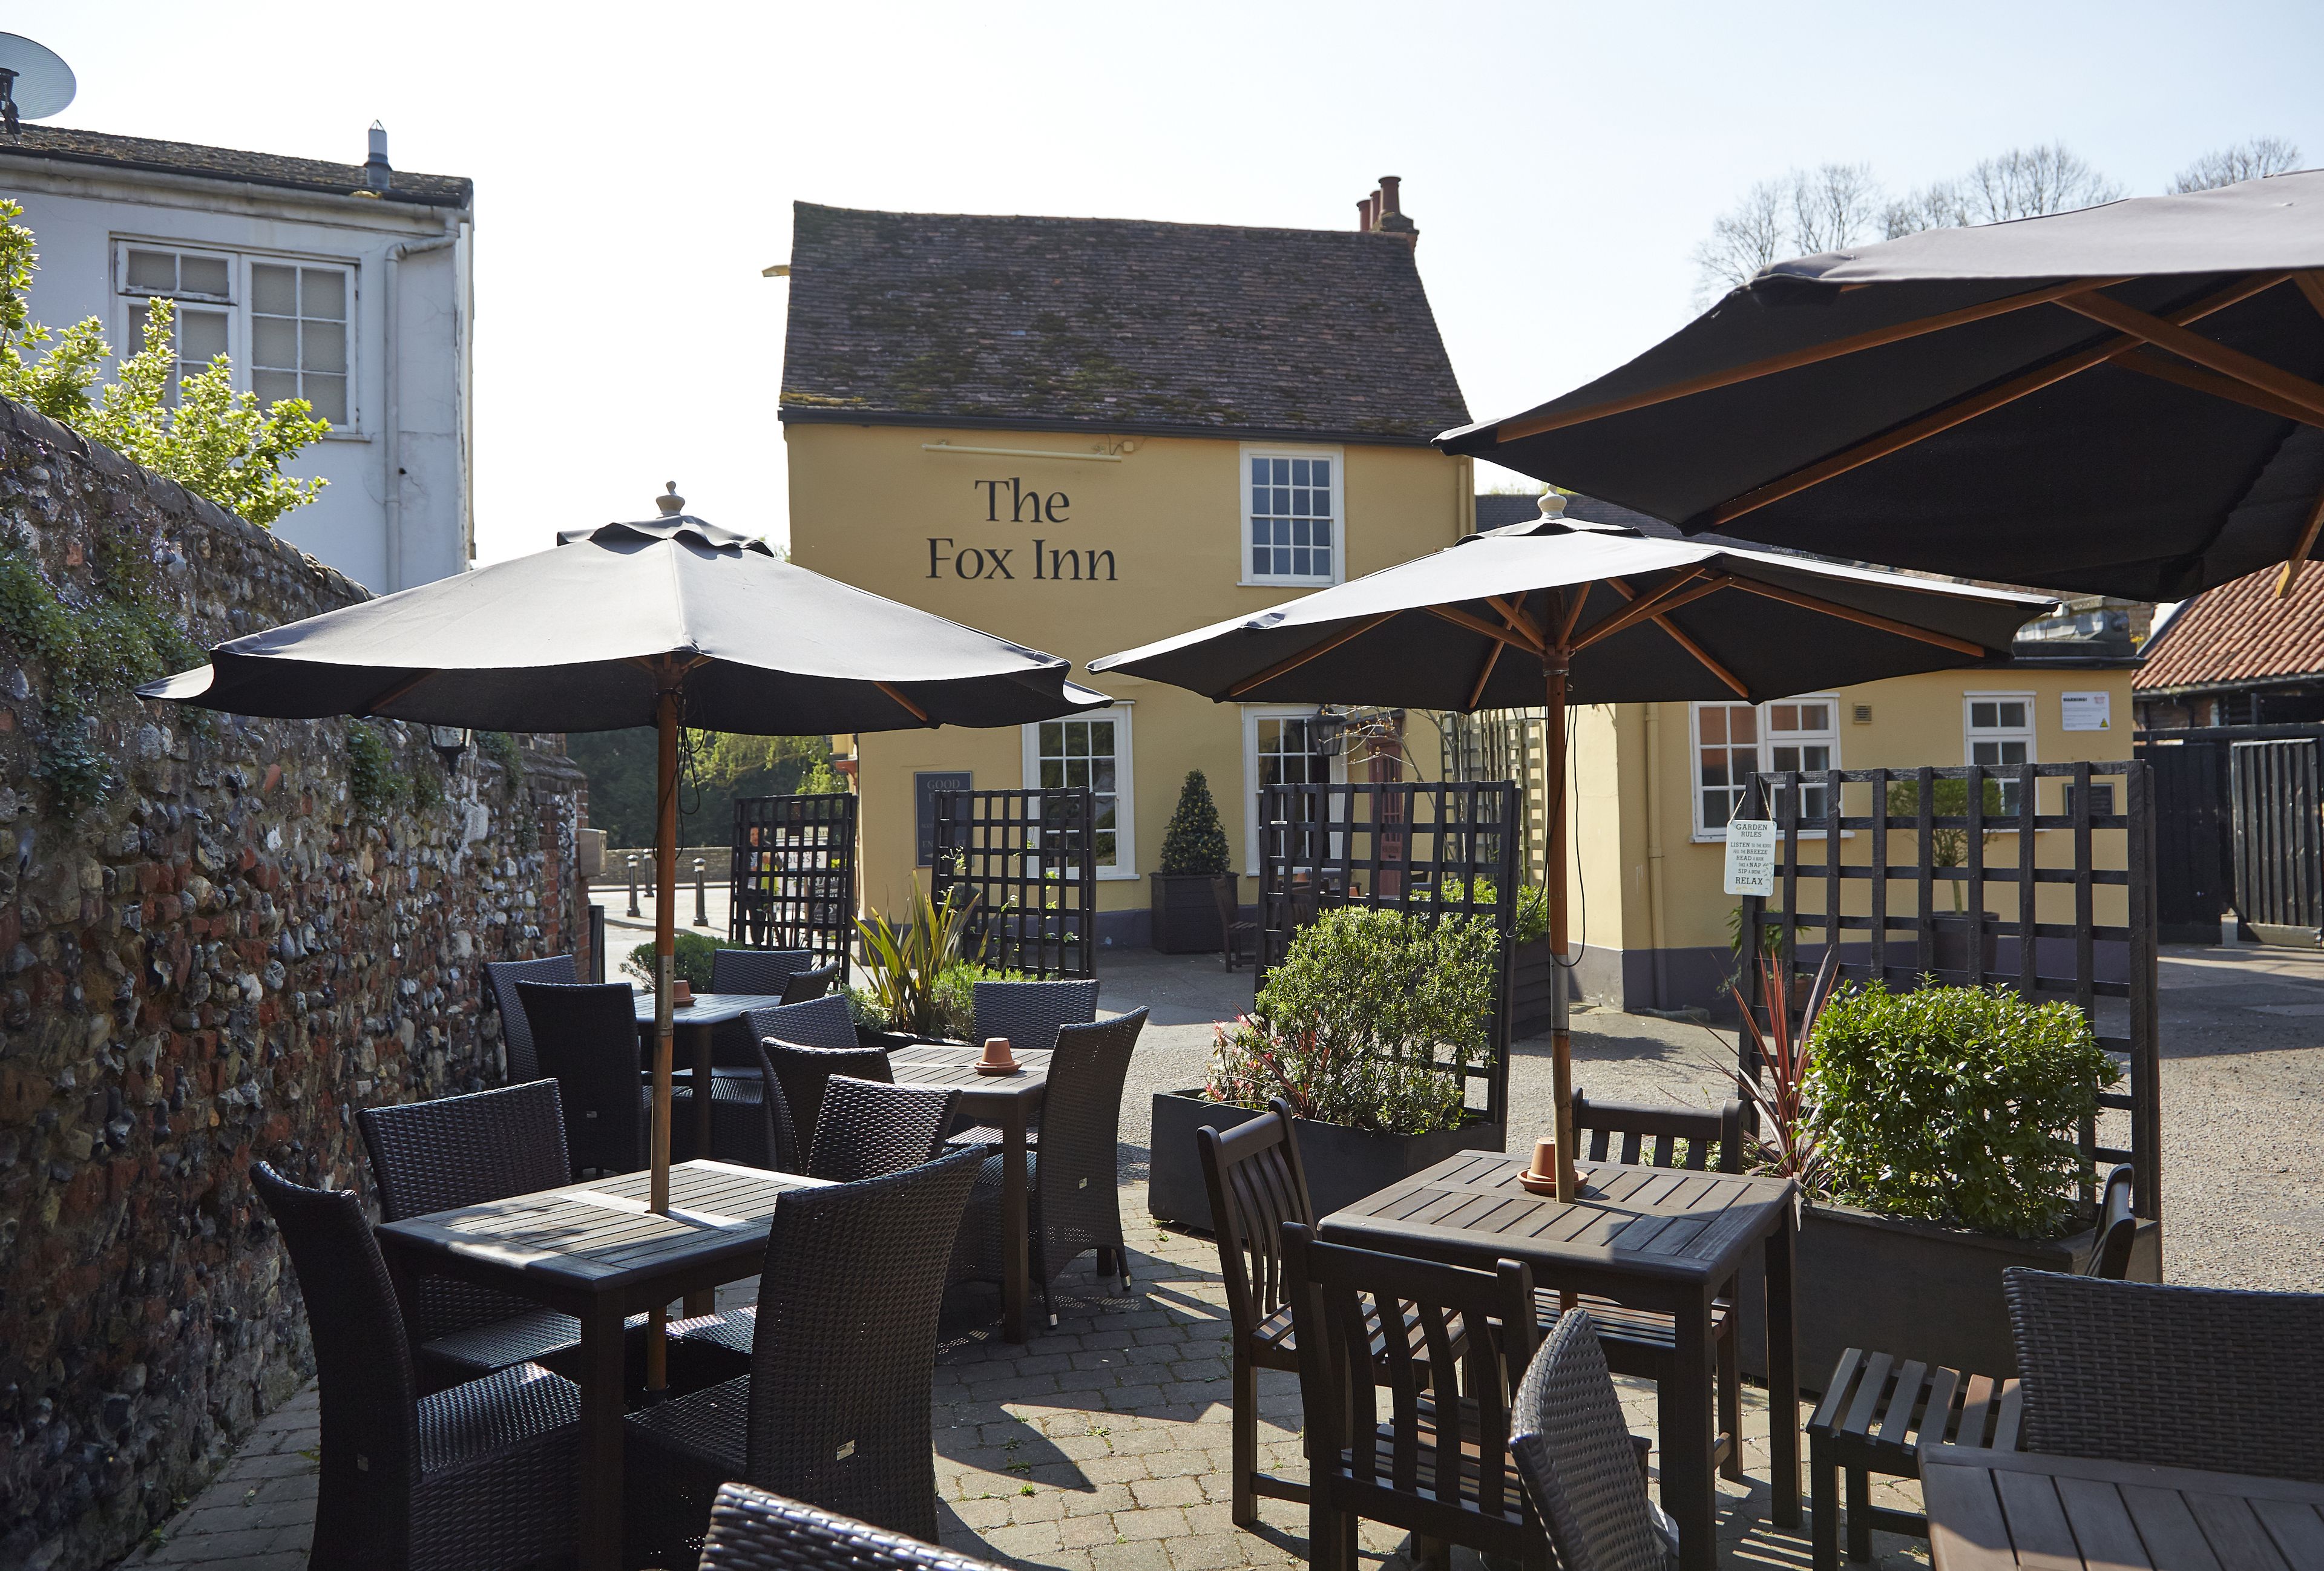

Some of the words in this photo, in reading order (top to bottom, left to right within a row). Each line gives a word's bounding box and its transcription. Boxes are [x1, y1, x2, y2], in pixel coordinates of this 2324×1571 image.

[974, 477, 1069, 522] The
[925, 538, 1015, 579] Fox
[1032, 539, 1118, 580] Inn
[927, 779, 960, 790] GOOD
[1735, 876, 1763, 885] RELAX
